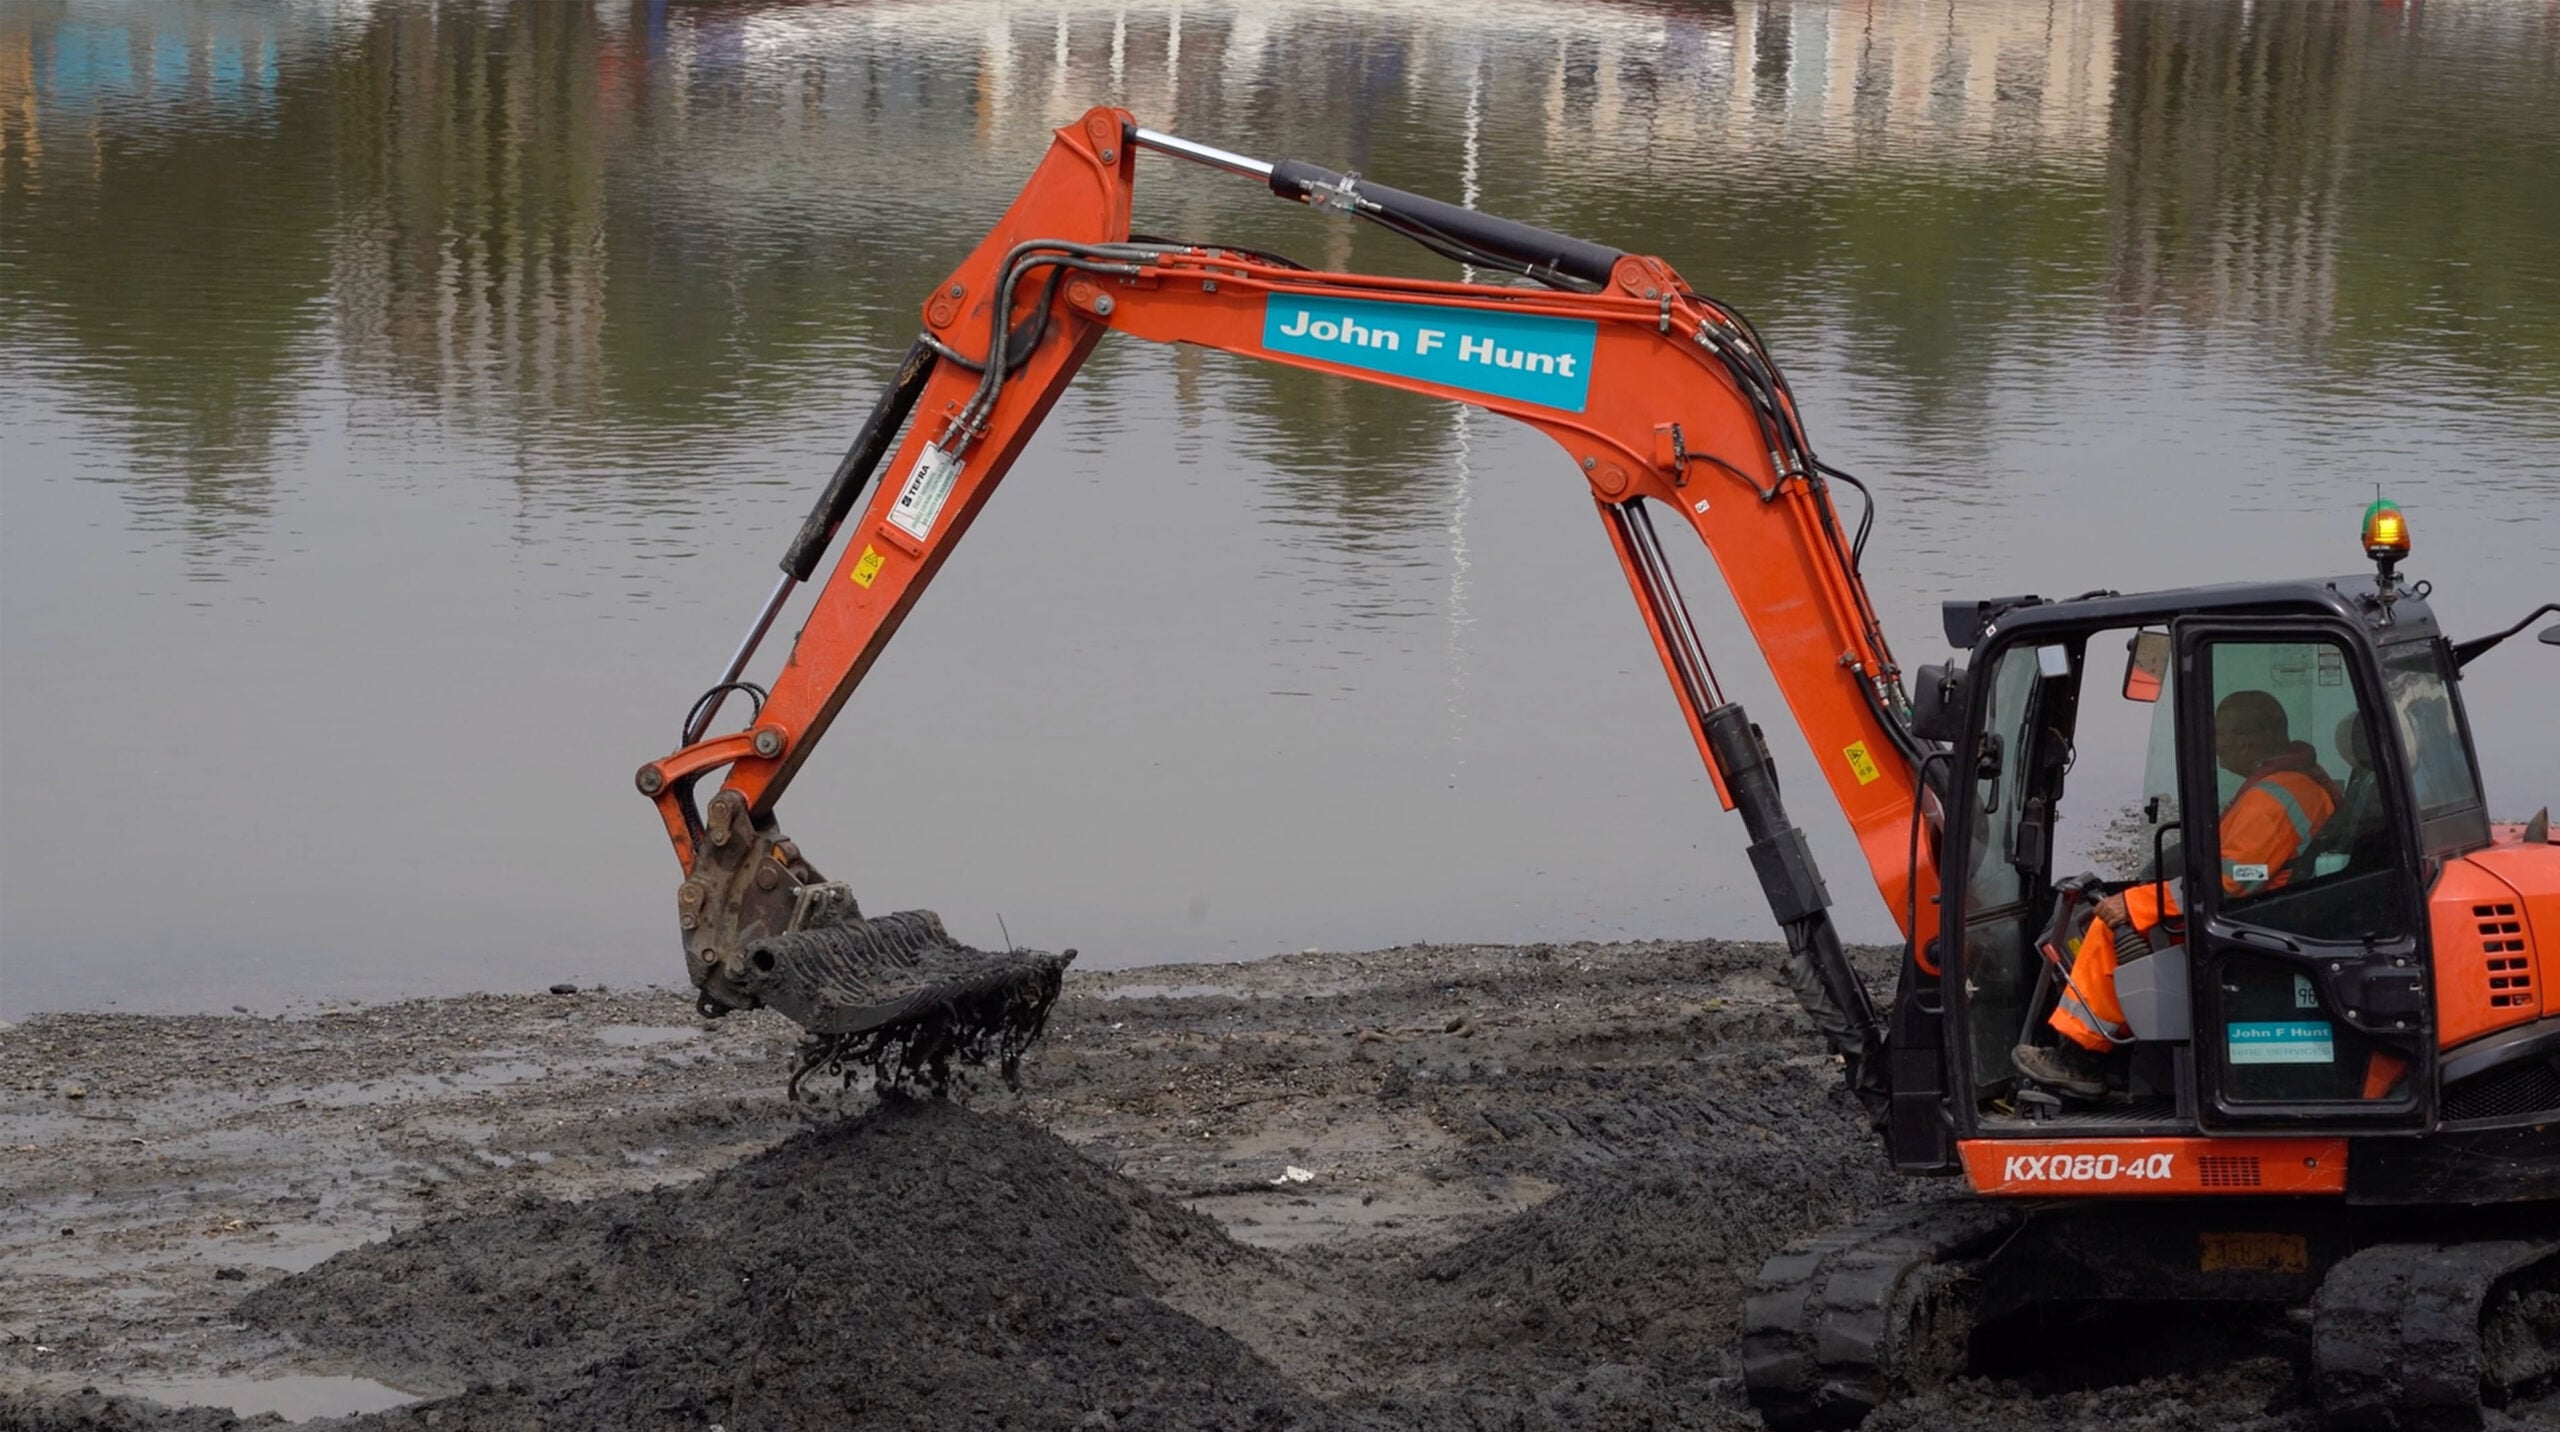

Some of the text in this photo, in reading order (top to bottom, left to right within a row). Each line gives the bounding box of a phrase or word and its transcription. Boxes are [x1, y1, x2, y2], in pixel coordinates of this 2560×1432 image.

[1279, 310, 1577, 378] John F Hunt
[908, 464, 930, 497] TEFRA
[2232, 1027, 2329, 1038] John F Hunt
